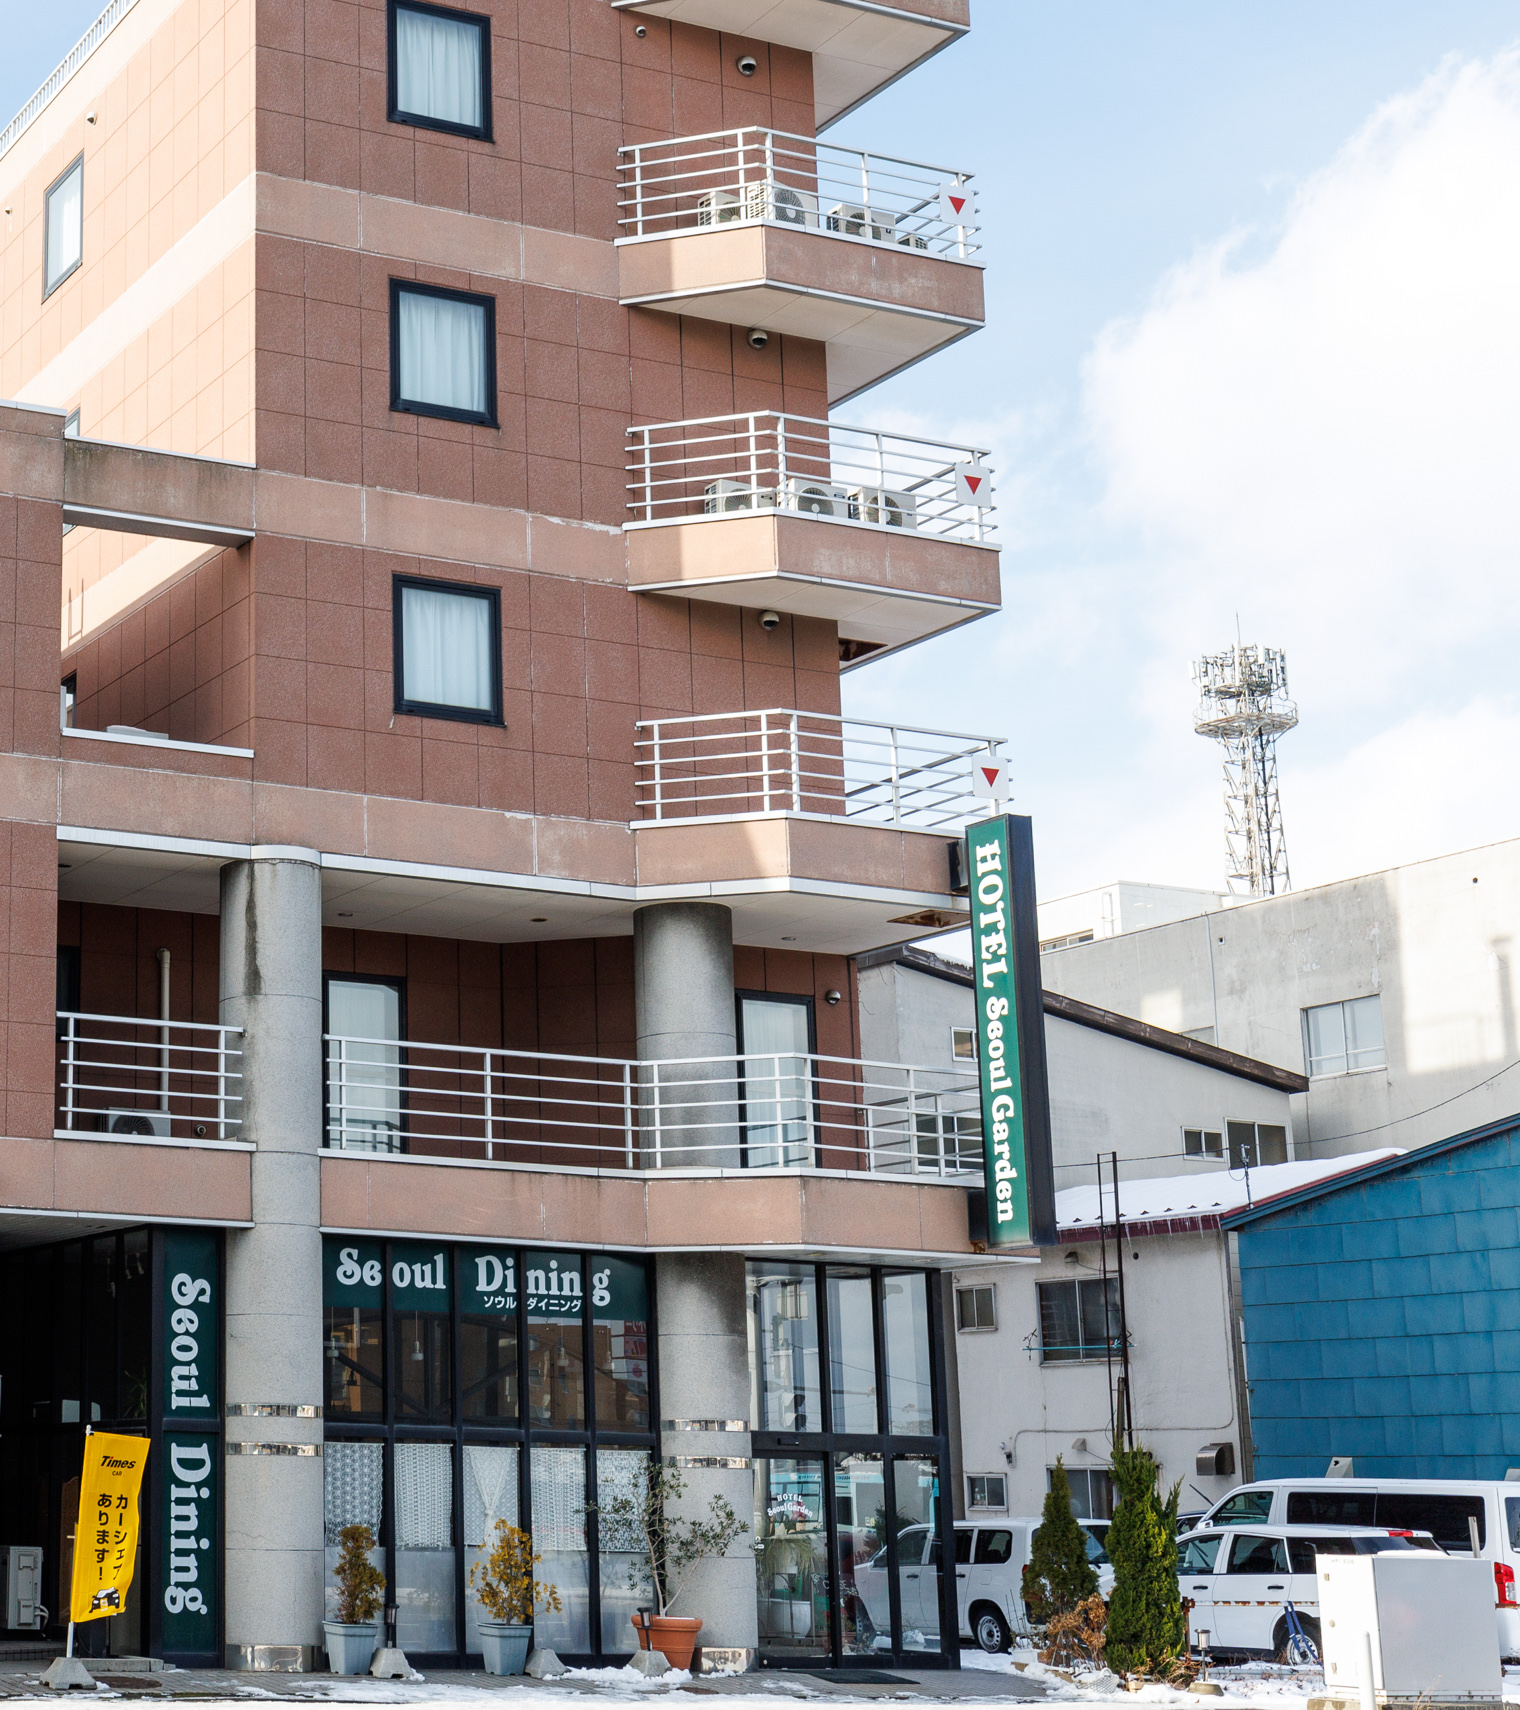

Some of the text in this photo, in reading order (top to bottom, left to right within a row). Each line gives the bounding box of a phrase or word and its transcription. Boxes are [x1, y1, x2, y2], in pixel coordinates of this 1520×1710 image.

[975, 839, 1018, 1224] HOTEL Seoul Garden
[336, 1247, 612, 1307] Seoul Dining
[526, 1297, 583, 1313] ダイニング
[100, 1455, 136, 1469] Times
[164, 1272, 212, 1615] Seoul Dining
[767, 1502, 814, 1518] Seoul Garden
[776, 1493, 804, 1503] HOTEL
[113, 1494, 129, 1580] カーシェア
